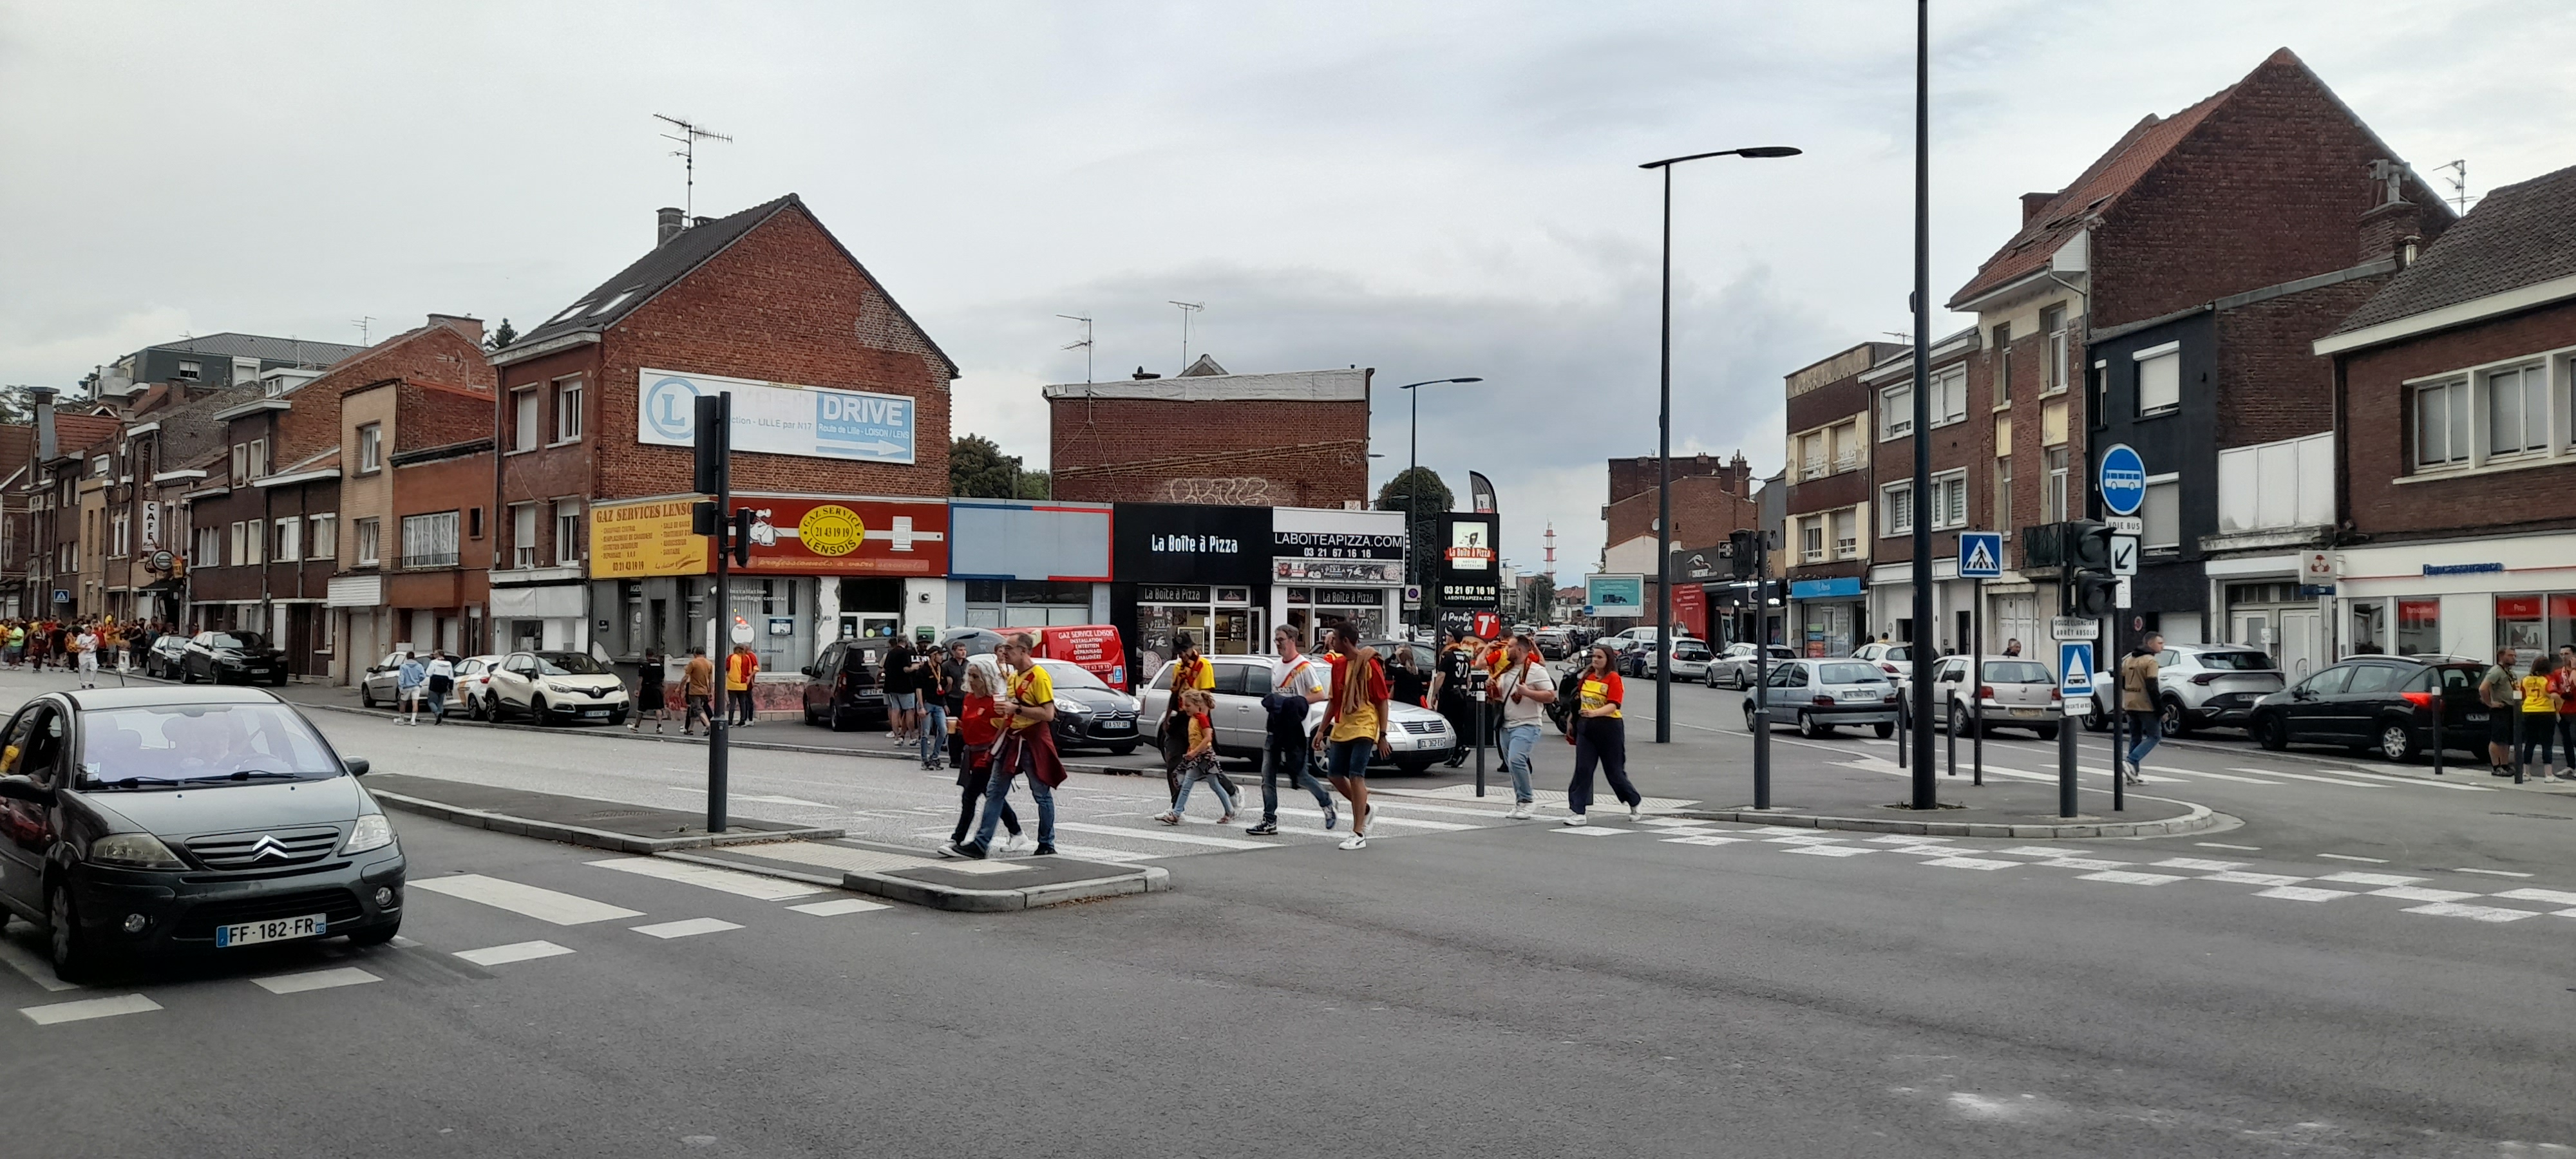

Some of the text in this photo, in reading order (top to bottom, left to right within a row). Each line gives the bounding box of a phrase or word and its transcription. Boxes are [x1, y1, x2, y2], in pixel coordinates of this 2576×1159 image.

[822, 395, 903, 426] DRIVE
[759, 419, 781, 428] LILLE
[783, 421, 795, 430] par
[797, 422, 812, 430] N17
[819, 423, 837, 433] Route
[838, 425, 846, 433] de
[847, 426, 860, 435] Lille
[596, 502, 693, 523] GAZ SERVICES LENSO
[803, 507, 862, 529] GAZ SERVICE
[146, 503, 155, 540] CAFE
[815, 527, 850, 538] 21 43 19 19
[806, 538, 857, 554] LENSOIS
[1151, 534, 1238, 553] La Boîte à Pizza
[1274, 532, 1403, 547] LABOITEAPIZZA.COM
[1304, 547, 1314, 557] 03
[1318, 548, 1327, 557] 21
[1332, 549, 1342, 558] 67
[1347, 549, 1357, 558] 16
[1449, 548, 1456, 557] La
[1472, 548, 1475, 557] à
[1476, 549, 1491, 558] Pizza
[619, 561, 624, 571] 21
[632, 561, 638, 570] 19
[639, 560, 644, 570] 19
[1144, 587, 1200, 601] La Boîte à Pizza
[1322, 590, 1374, 603] La Boîte à Pizza
[1444, 585, 1495, 595] 03 21 67 16 16
[1071, 630, 1093, 639] SERVICE
